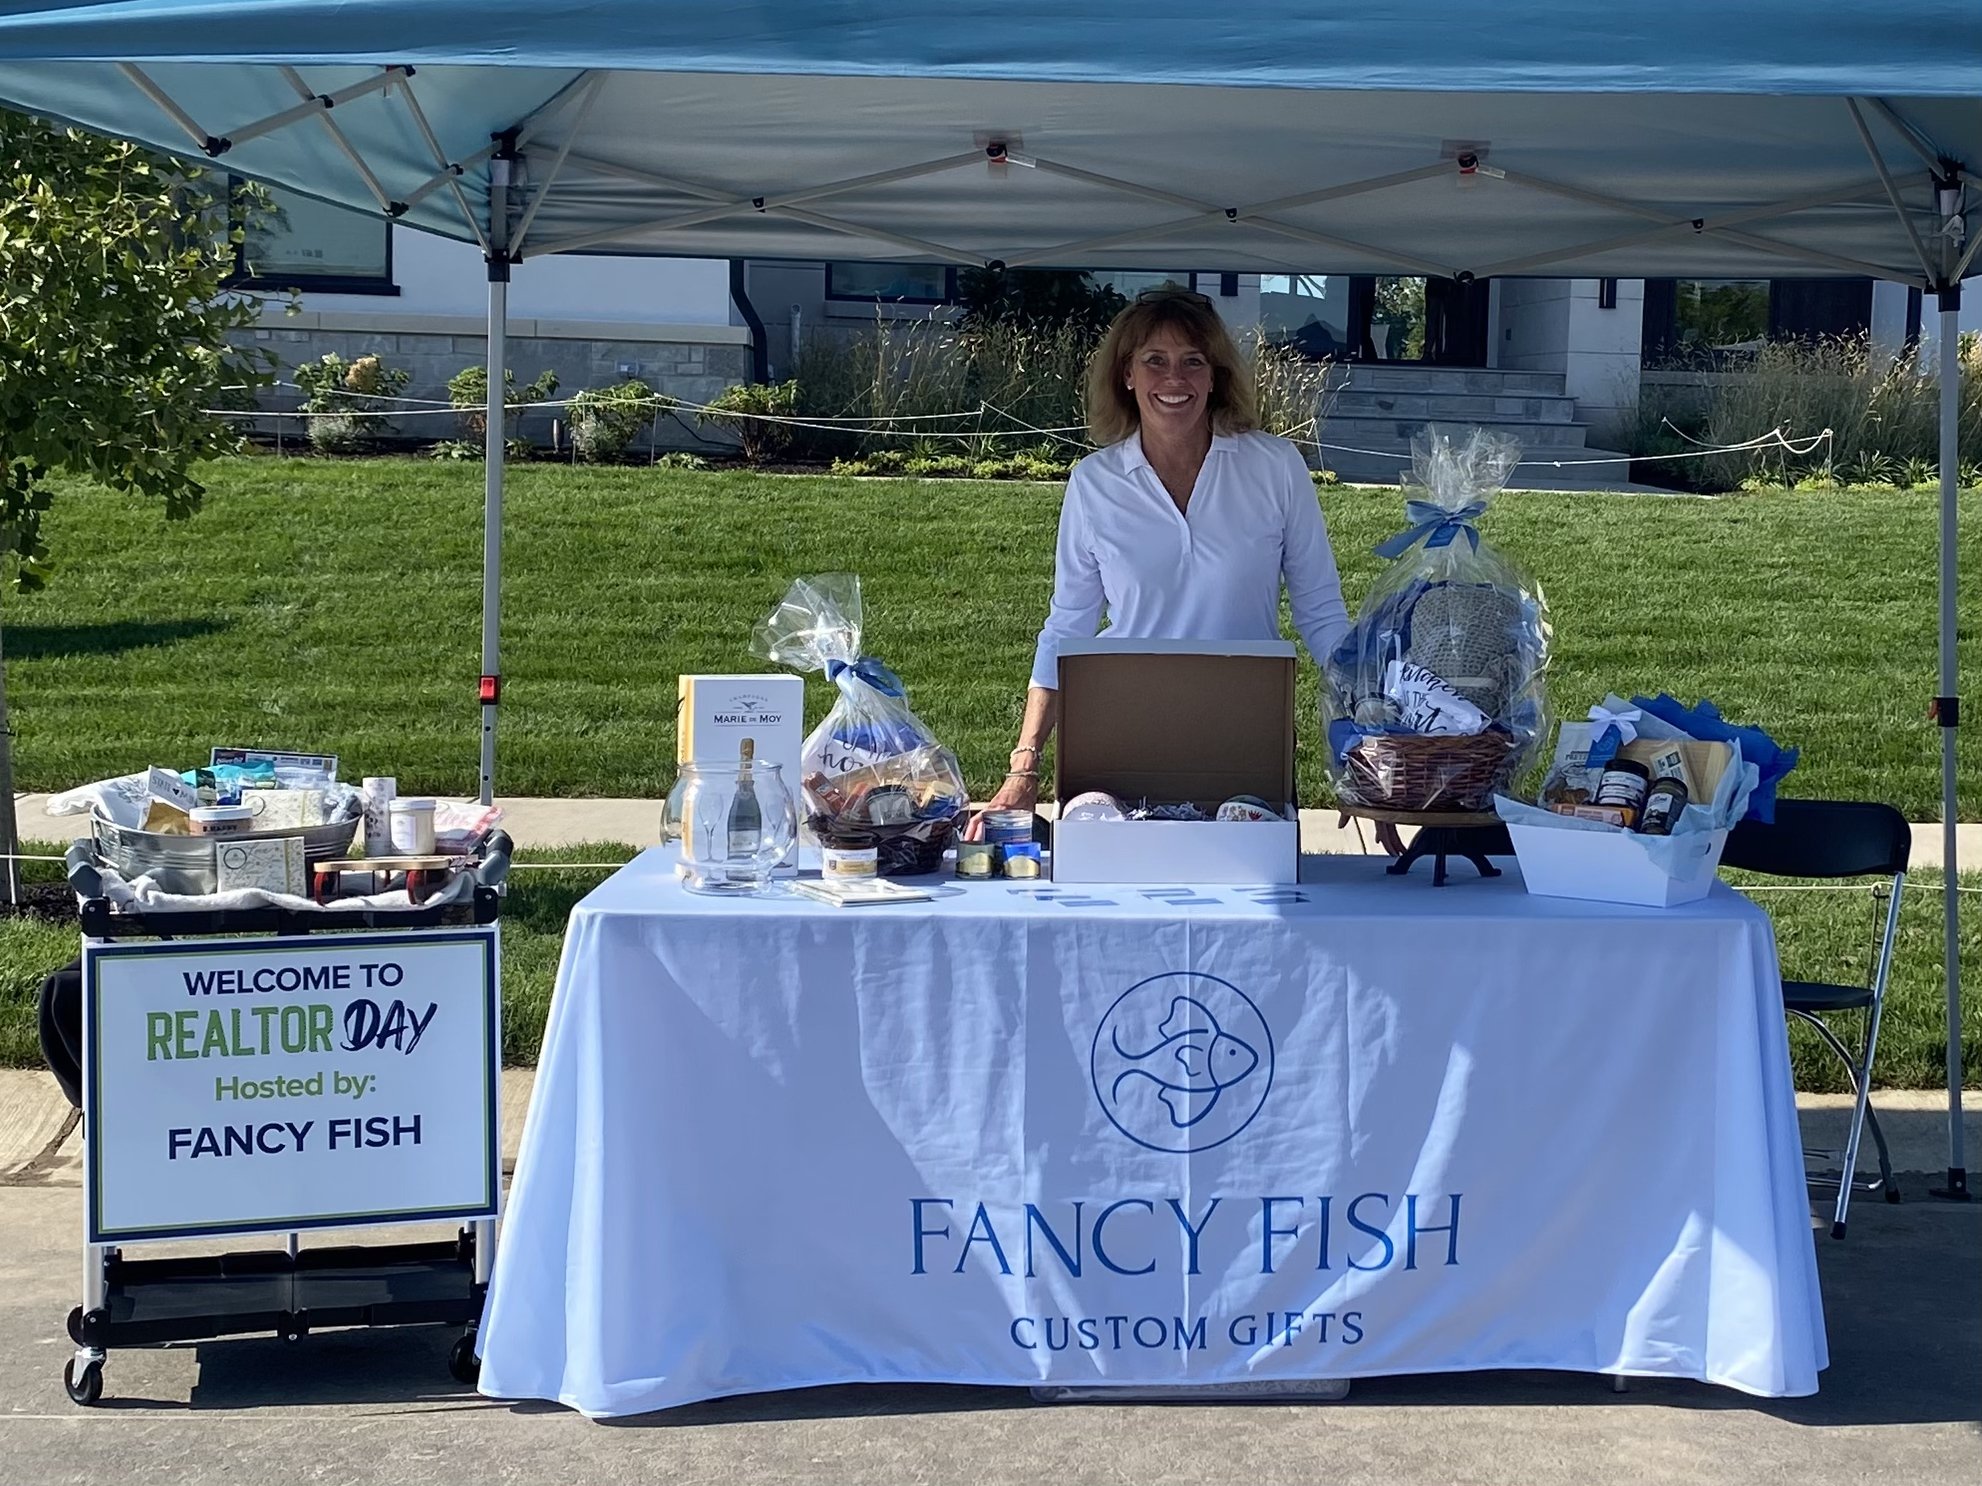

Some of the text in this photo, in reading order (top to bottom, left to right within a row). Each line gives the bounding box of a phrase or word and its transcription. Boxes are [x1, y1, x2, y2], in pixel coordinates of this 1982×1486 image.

[714, 715, 747, 723] MARIE
[760, 715, 782, 723] MOY
[183, 963, 403, 995] WELCOME TO
[147, 999, 438, 1061] REALTOR DAY
[216, 1071, 376, 1101] Hosted by:
[169, 1115, 421, 1160] FANCY FISH
[909, 1193, 1463, 1278] FANCY FISH
[1011, 1312, 1363, 1351] CUSTOM GIFTS
